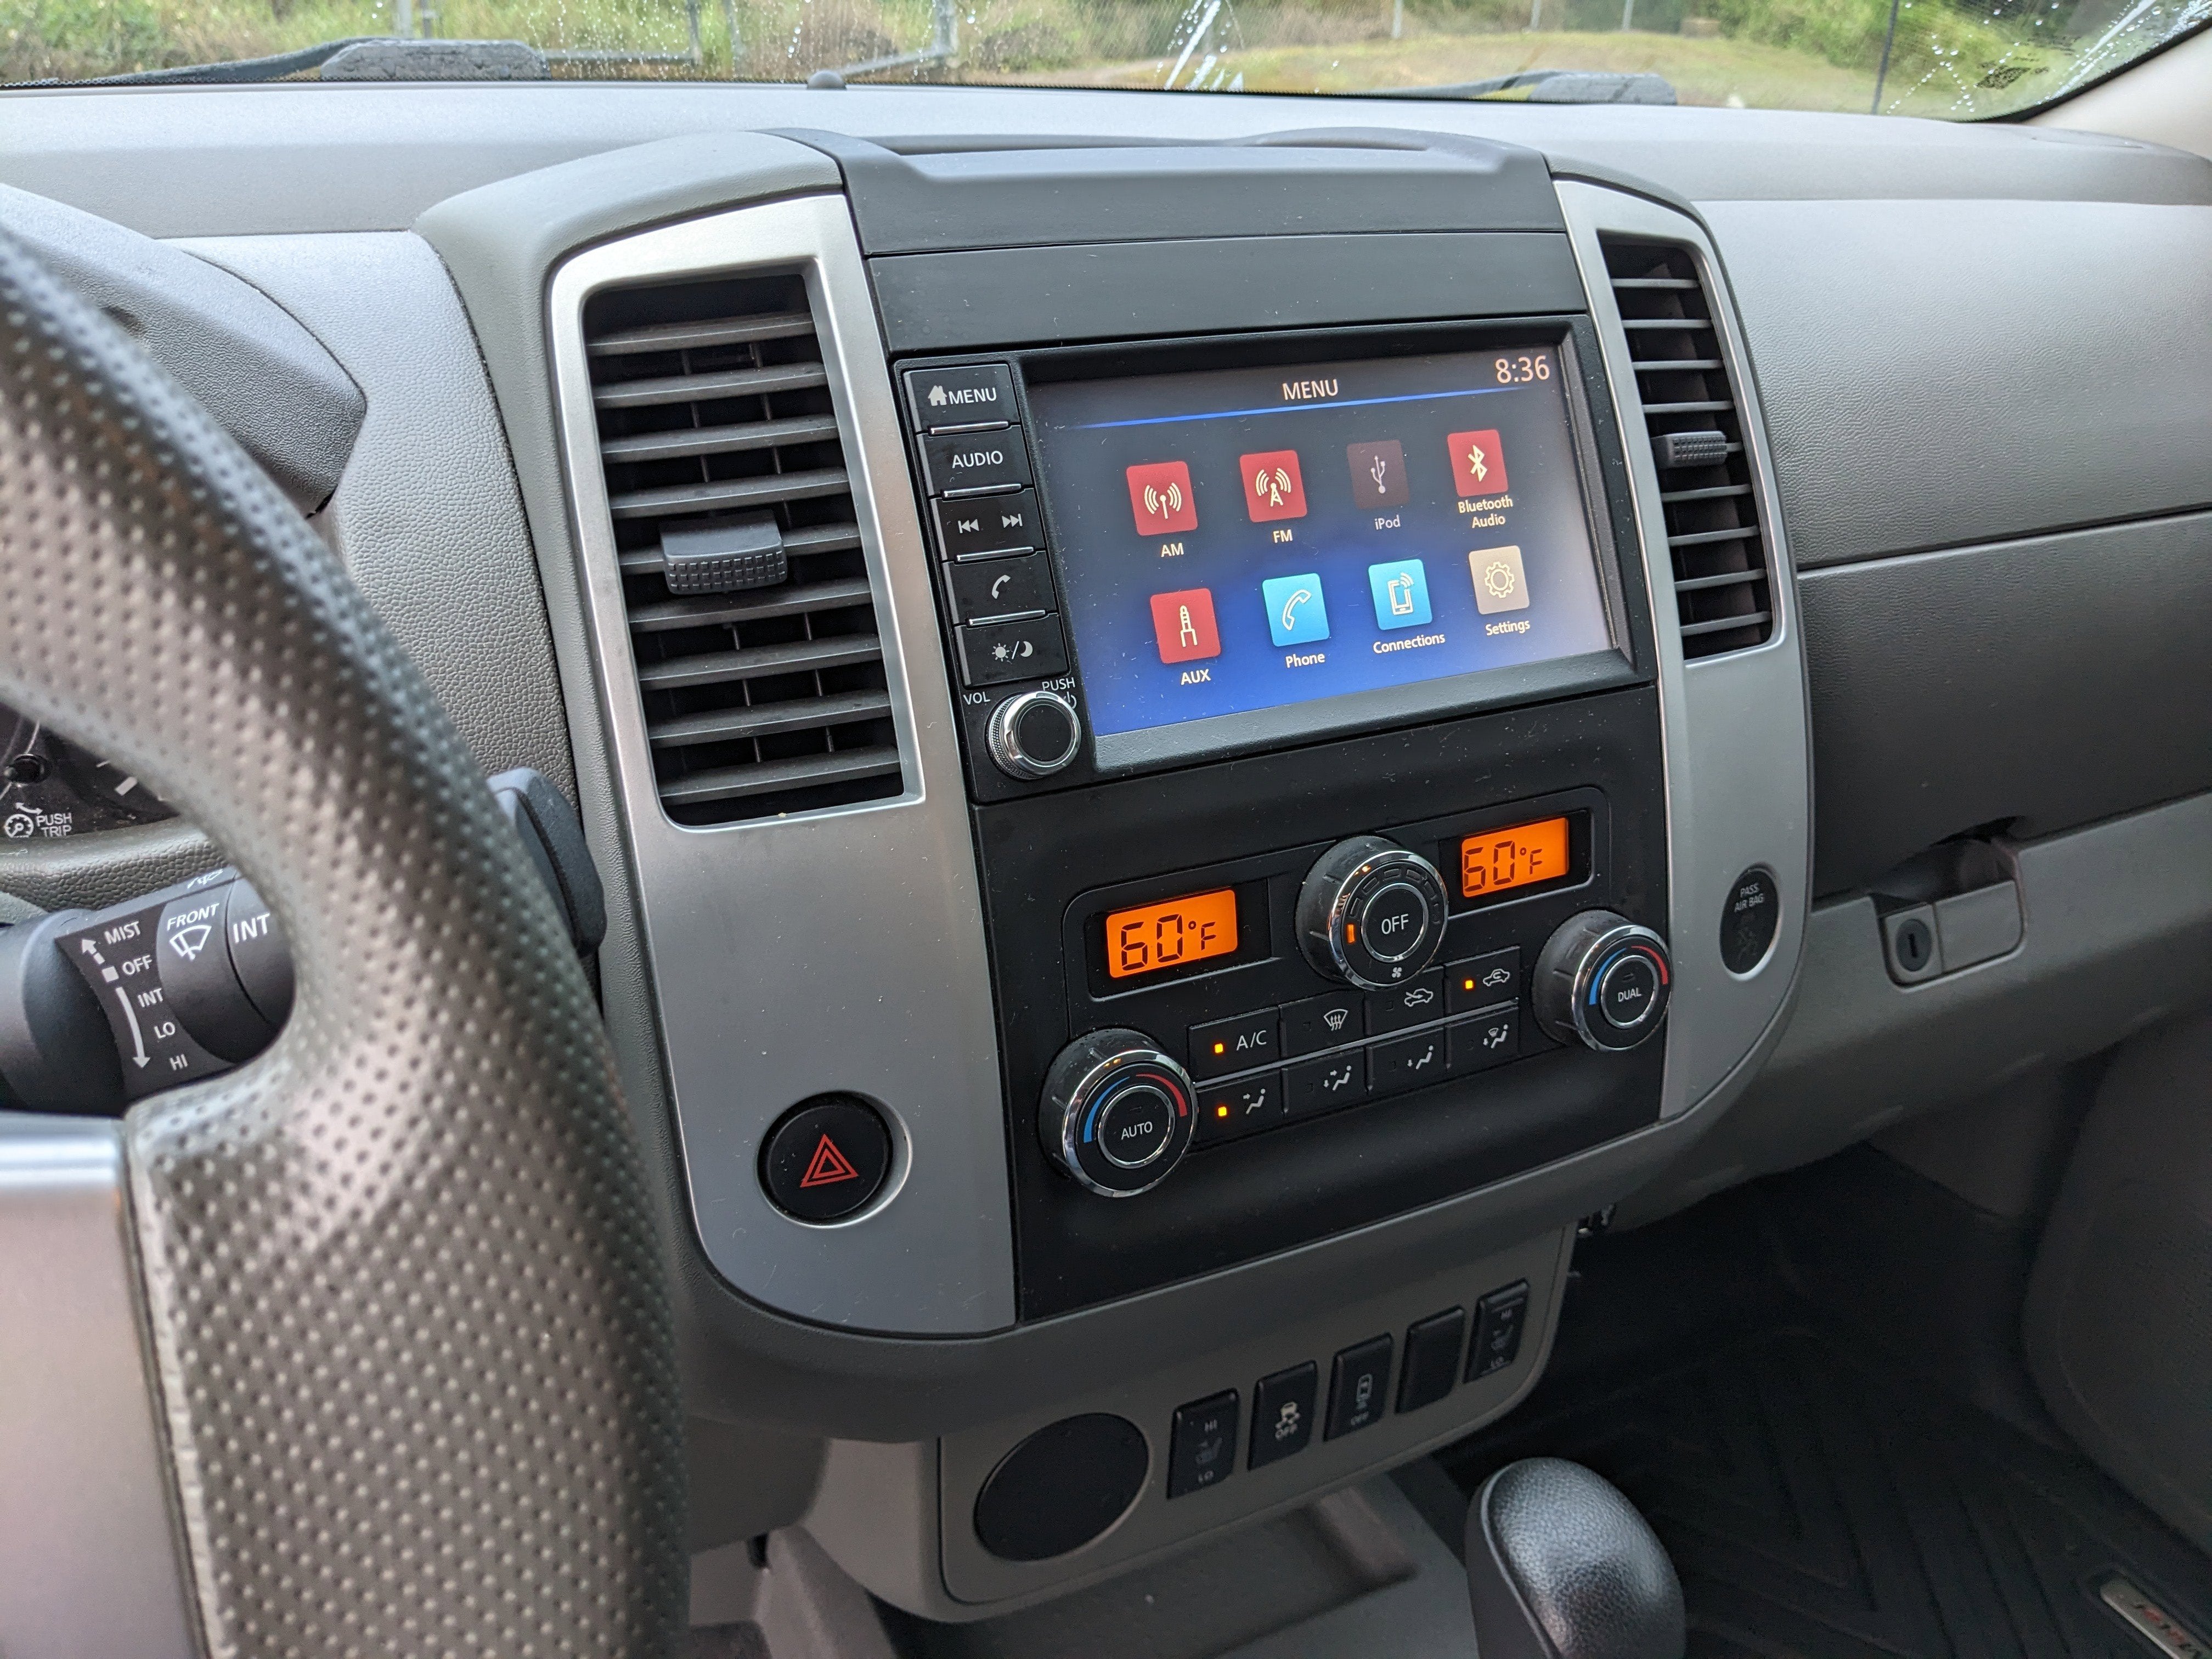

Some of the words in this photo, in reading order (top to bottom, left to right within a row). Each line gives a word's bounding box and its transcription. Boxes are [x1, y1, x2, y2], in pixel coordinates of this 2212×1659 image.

[1495, 355, 1550, 383] 8:36
[948, 387, 997, 405] MENU
[1282, 379, 1339, 400] MENU
[952, 450, 1003, 469] AUDIO
[1458, 494, 1514, 514] Bluetooth
[1374, 514, 1401, 530] iPod
[1471, 514, 1506, 529] Audio
[1273, 529, 1294, 543] FM
[1161, 543, 1185, 557] AM
[1485, 619, 1531, 636] Settings
[1373, 634, 1446, 654] Connections
[1285, 653, 1325, 668] Phone
[1042, 677, 1076, 691] PUSH
[1181, 668, 1211, 685] AUX
[963, 691, 991, 705] VOL
[36, 812, 72, 827] PUSH
[41, 825, 72, 837] TRIP
[1740, 883, 1760, 899] PASS
[1734, 899, 1748, 913] AIR
[1748, 893, 1765, 907] BAG
[166, 902, 220, 931] FRONT
[1381, 913, 1409, 934] OFF
[104, 920, 140, 945] MIST
[233, 913, 270, 943] INT
[122, 954, 153, 975] OFF
[138, 988, 163, 1008] INT
[1618, 987, 1642, 1002] DUAL
[154, 1022, 176, 1039] LO
[1236, 1030, 1267, 1051] A/C
[170, 1054, 188, 1070] HI
[1121, 1120, 1153, 1141] AUTO
